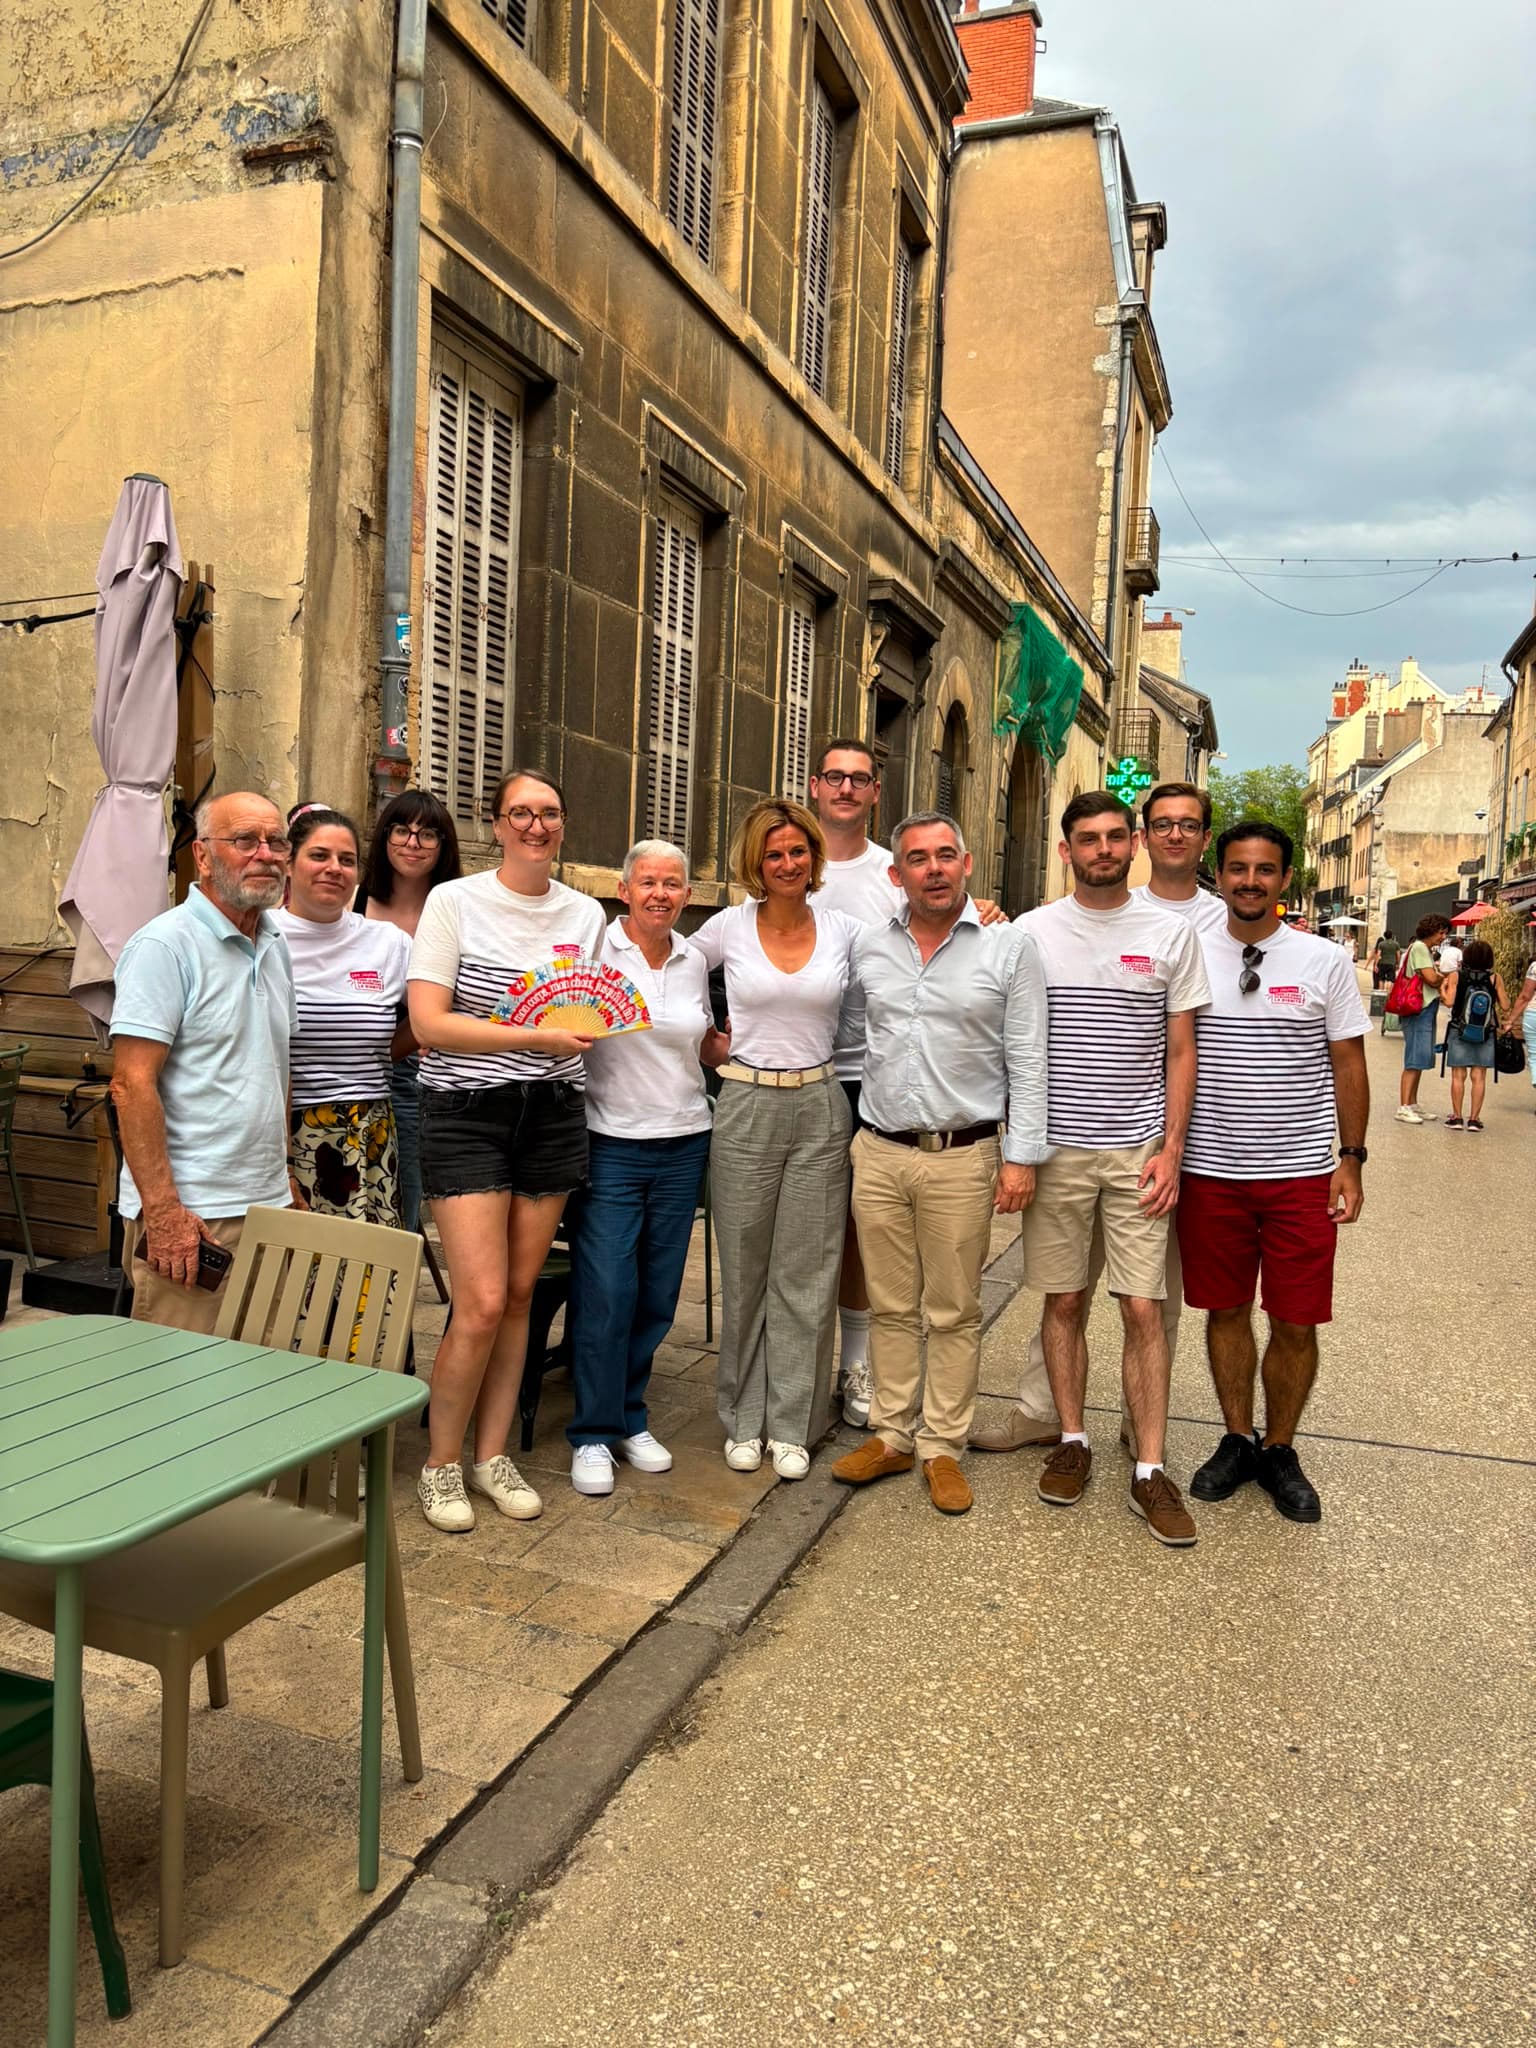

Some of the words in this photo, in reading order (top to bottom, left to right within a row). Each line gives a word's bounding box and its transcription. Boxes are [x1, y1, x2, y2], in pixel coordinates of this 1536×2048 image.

[514, 1003, 531, 1021] mon
[550, 980, 570, 993] mon
[622, 1005, 635, 1020] fin
